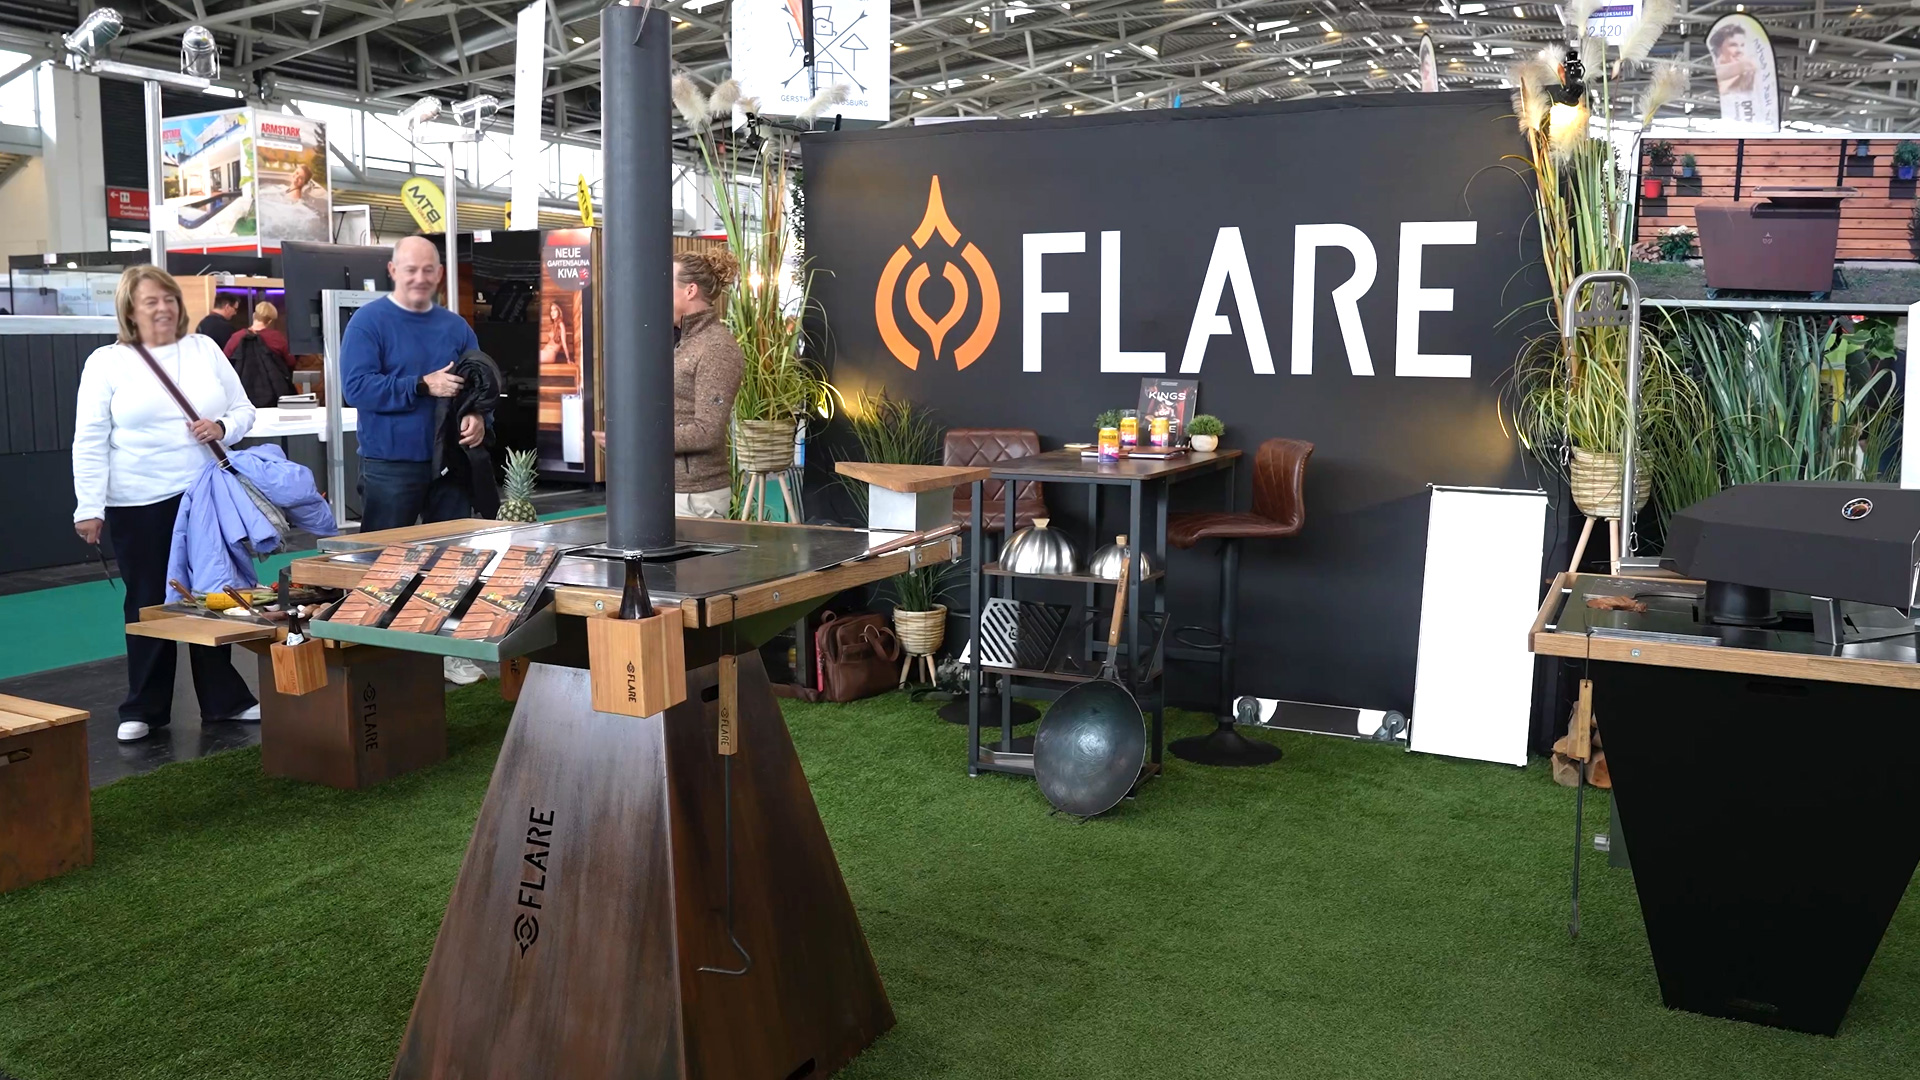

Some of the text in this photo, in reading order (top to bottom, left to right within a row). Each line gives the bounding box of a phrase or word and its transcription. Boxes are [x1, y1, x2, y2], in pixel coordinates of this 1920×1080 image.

[261, 122, 301, 137] ARMSTARK
[547, 259, 590, 267] GARTENSAUNA
[555, 247, 581, 258] NEUE
[558, 268, 579, 278] KIVA
[1022, 221, 1478, 378] FLARE
[1148, 391, 1187, 400] KINGS
[627, 674, 637, 703] FLARE
[364, 703, 379, 752] FLARE
[721, 718, 730, 747] FLARE
[518, 806, 555, 910] FLARE
